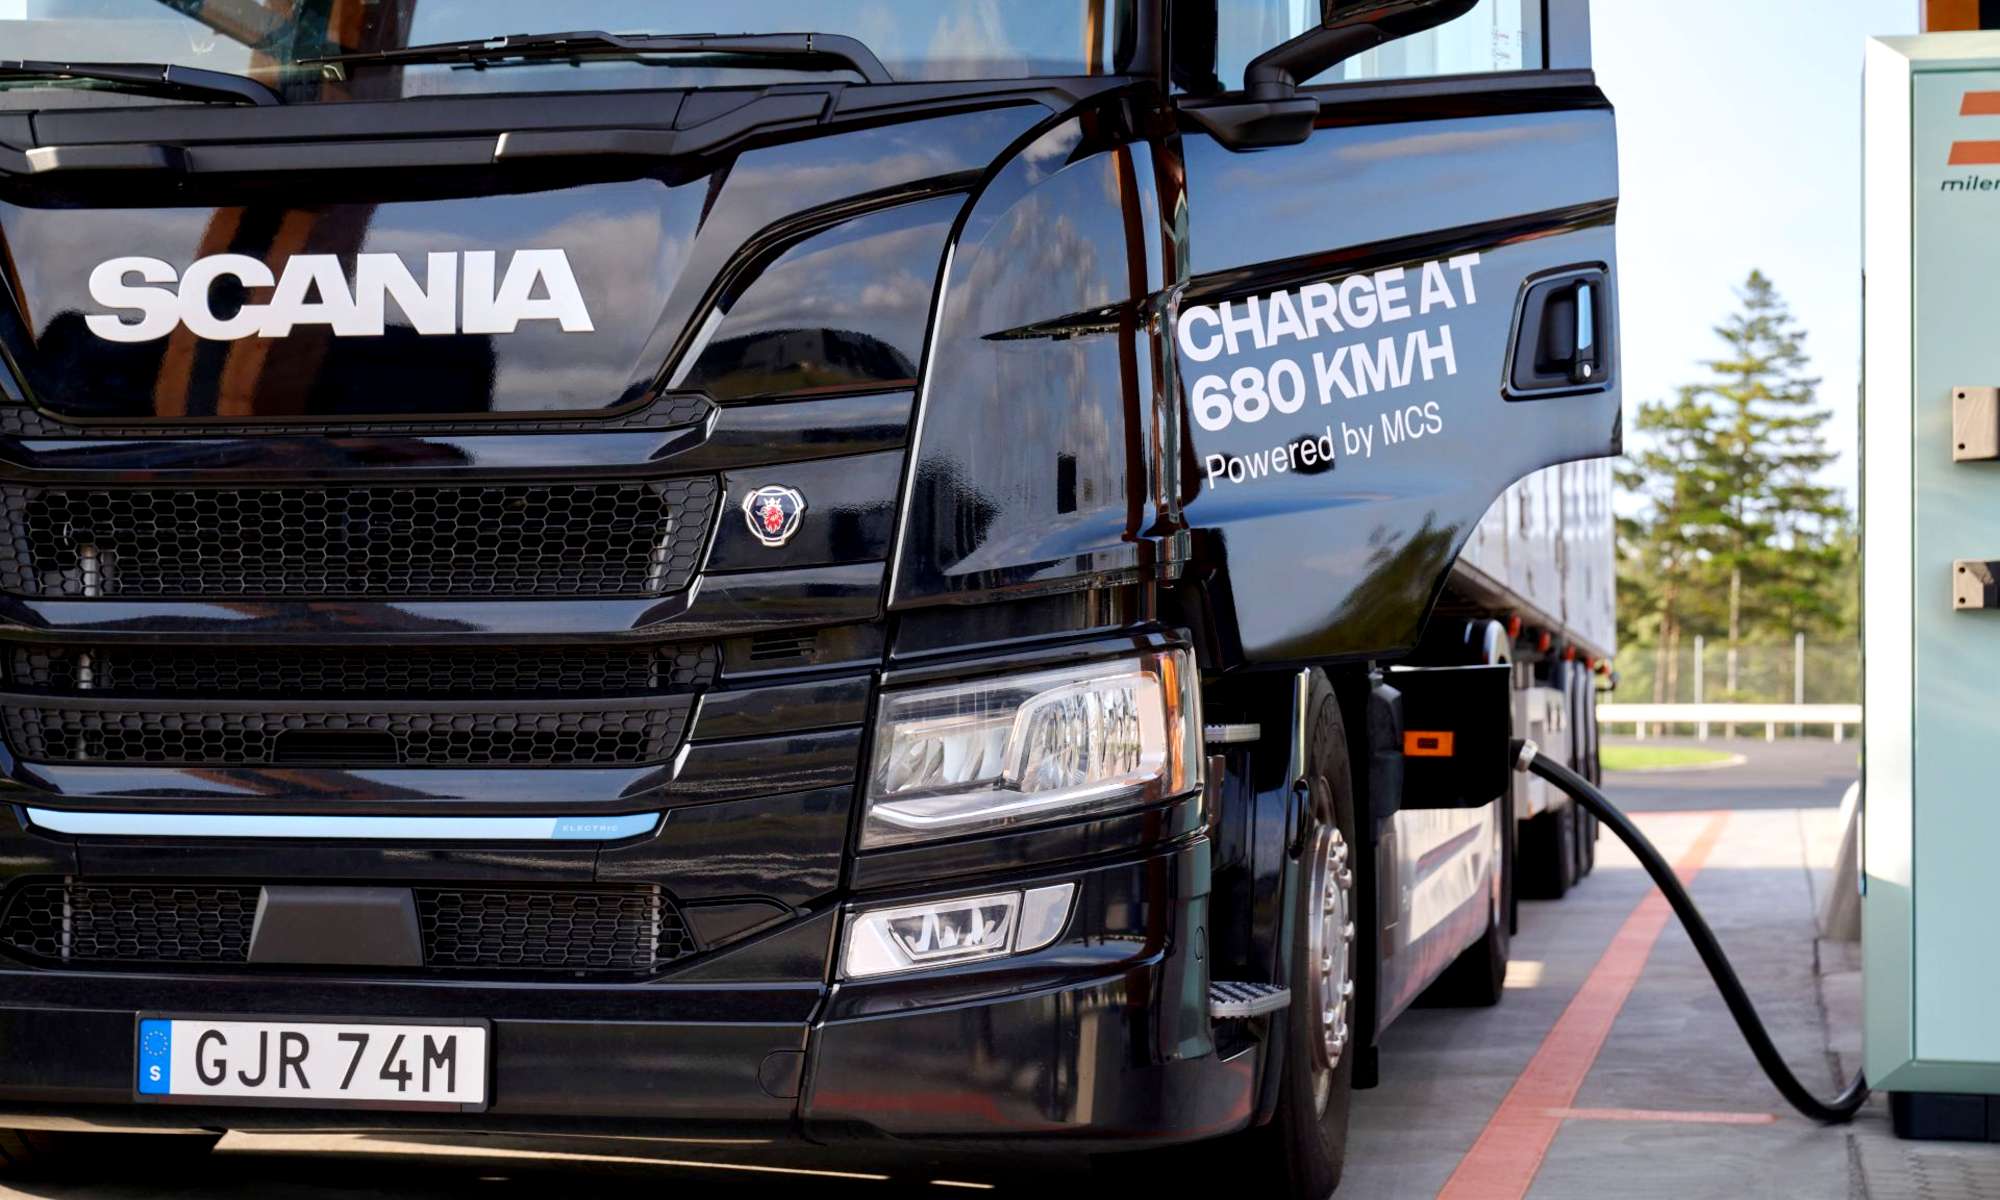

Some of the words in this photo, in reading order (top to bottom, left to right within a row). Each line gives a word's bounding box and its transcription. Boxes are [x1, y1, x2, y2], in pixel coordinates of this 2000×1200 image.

[85, 249, 595, 342] SCANIA
[1177, 268, 1411, 362] CHARGE
[1420, 253, 1482, 314] AT
[1191, 359, 1306, 431] 680
[1312, 325, 1457, 404] KM/H
[1205, 427, 1335, 490] Powered
[1342, 423, 1375, 459] by
[1381, 401, 1443, 446] MCS
[561, 823, 619, 833] ELECTRIC
[149, 1065, 162, 1083] S
[195, 1029, 312, 1089] GJR
[336, 1032, 458, 1094] 74M
